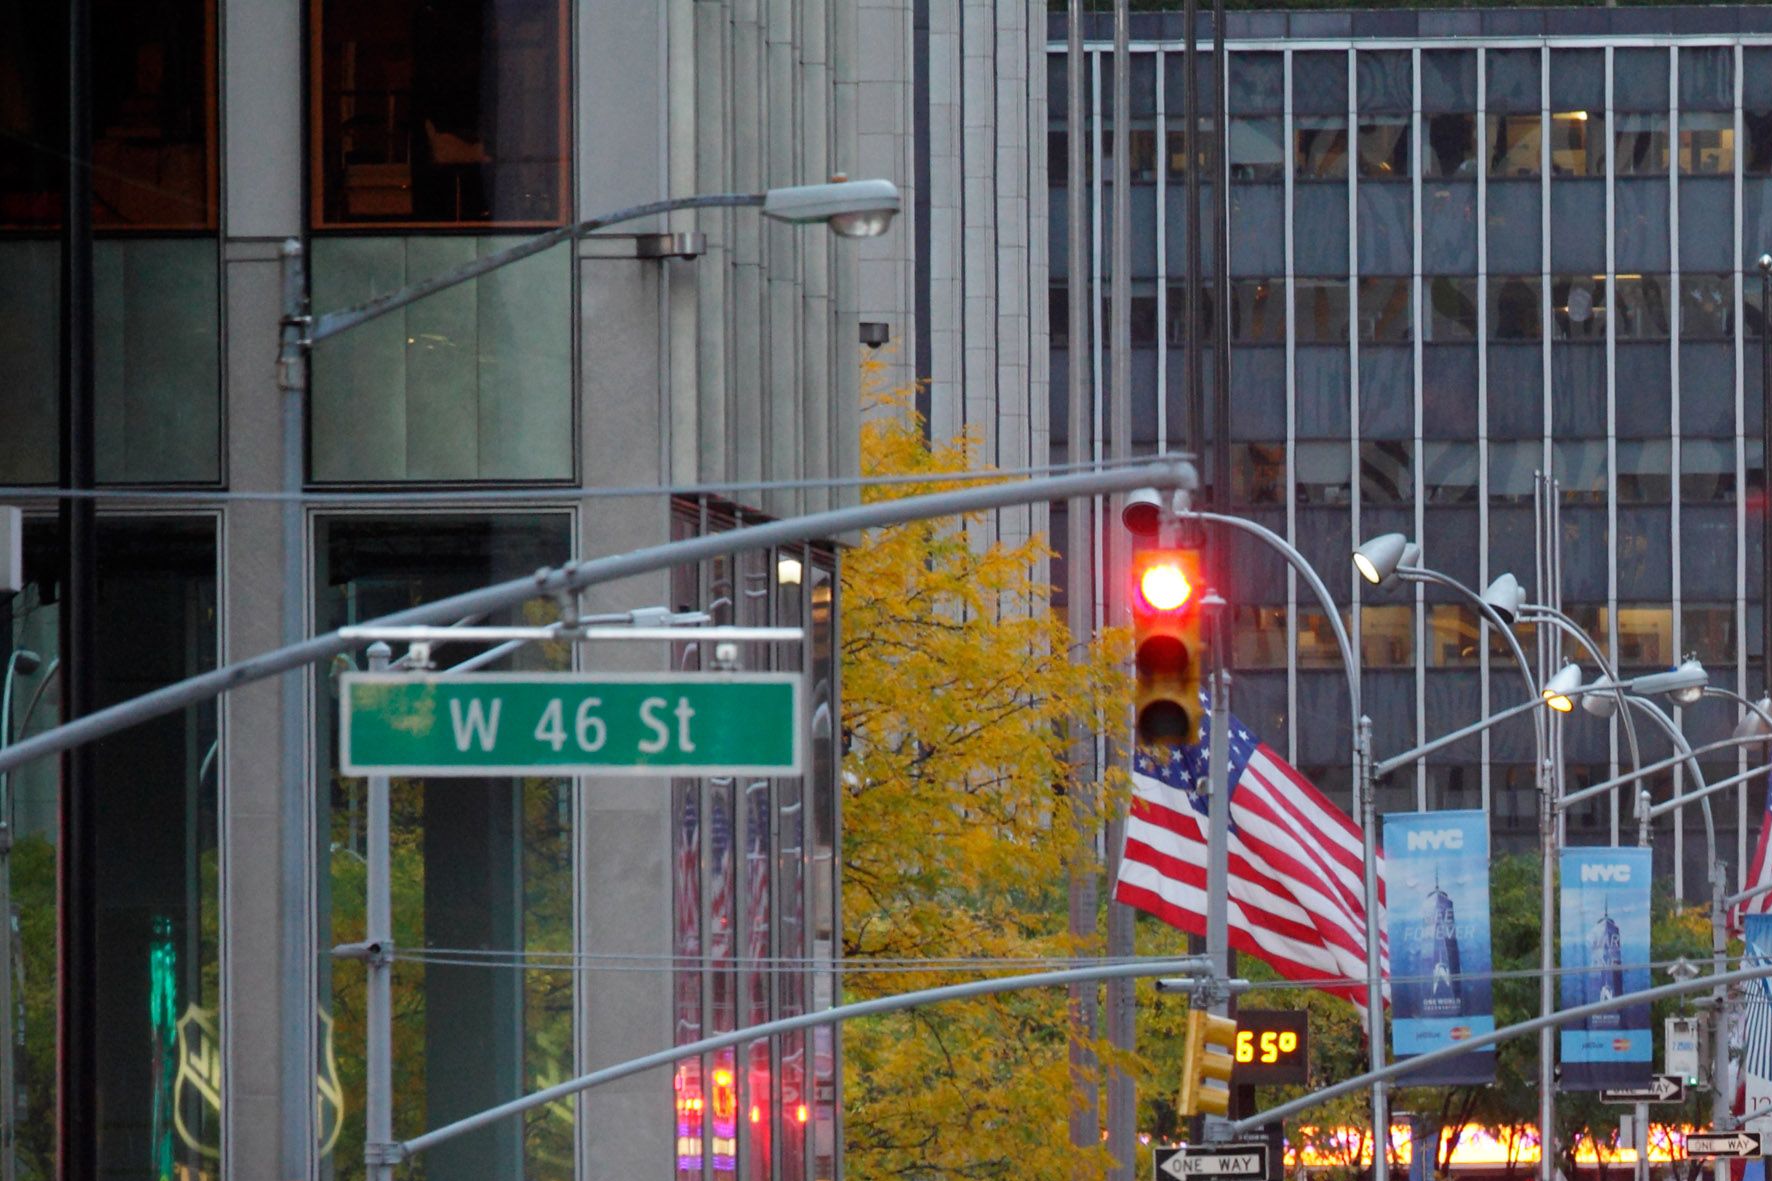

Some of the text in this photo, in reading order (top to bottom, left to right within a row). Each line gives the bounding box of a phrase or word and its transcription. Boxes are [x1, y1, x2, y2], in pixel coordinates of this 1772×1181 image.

[450, 697, 697, 753] W 46 St
[1407, 829, 1464, 851] NYC
[1581, 864, 1632, 882] NYC
[1404, 926, 1476, 942] FOREVER
[1695, 1139, 1750, 1151] ONE WAY
[1171, 1155, 1252, 1174] ONE WAY
